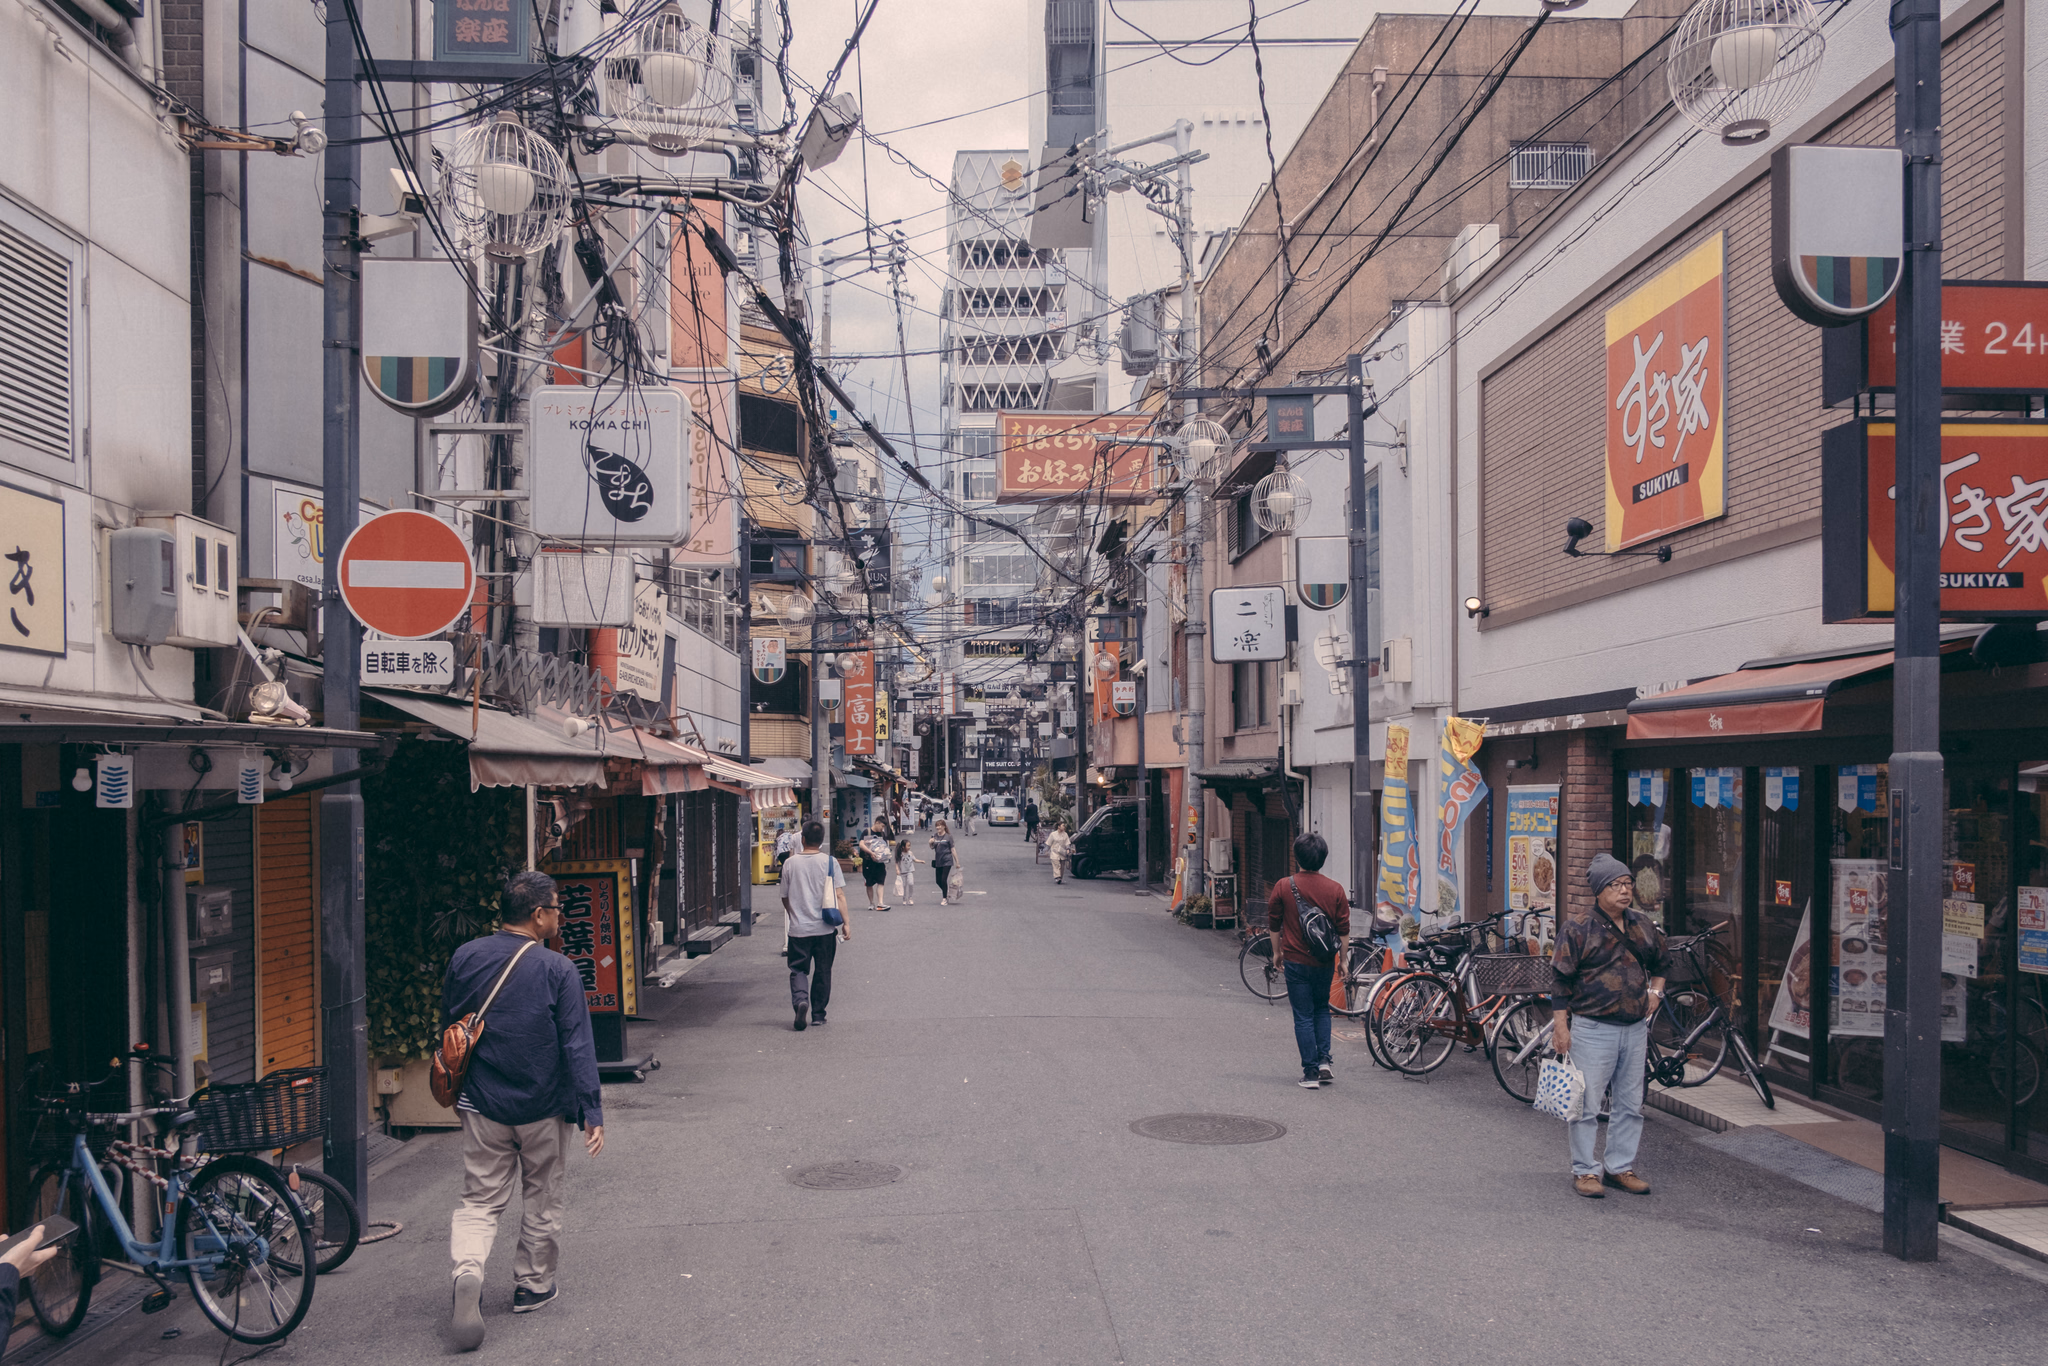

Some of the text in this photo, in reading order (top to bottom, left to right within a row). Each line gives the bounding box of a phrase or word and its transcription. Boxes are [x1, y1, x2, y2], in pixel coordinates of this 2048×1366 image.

[456, 17, 509, 43] 楽座
[1616, 330, 1710, 463] すき家
[570, 420, 648, 431] KOMACHI
[1278, 419, 1303, 432] 楽座
[1639, 475, 1681, 500] SUKIYA
[693, 539, 712, 552] 2F
[1939, 573, 2009, 588] SUKIYA
[366, 651, 449, 674] 自転車を除く
[847, 682, 873, 751] 一富士
[1510, 812, 1557, 832] ランチメニュー
[598, 881, 613, 945] しちりん焼肉
[558, 884, 597, 992] 若葉屋
